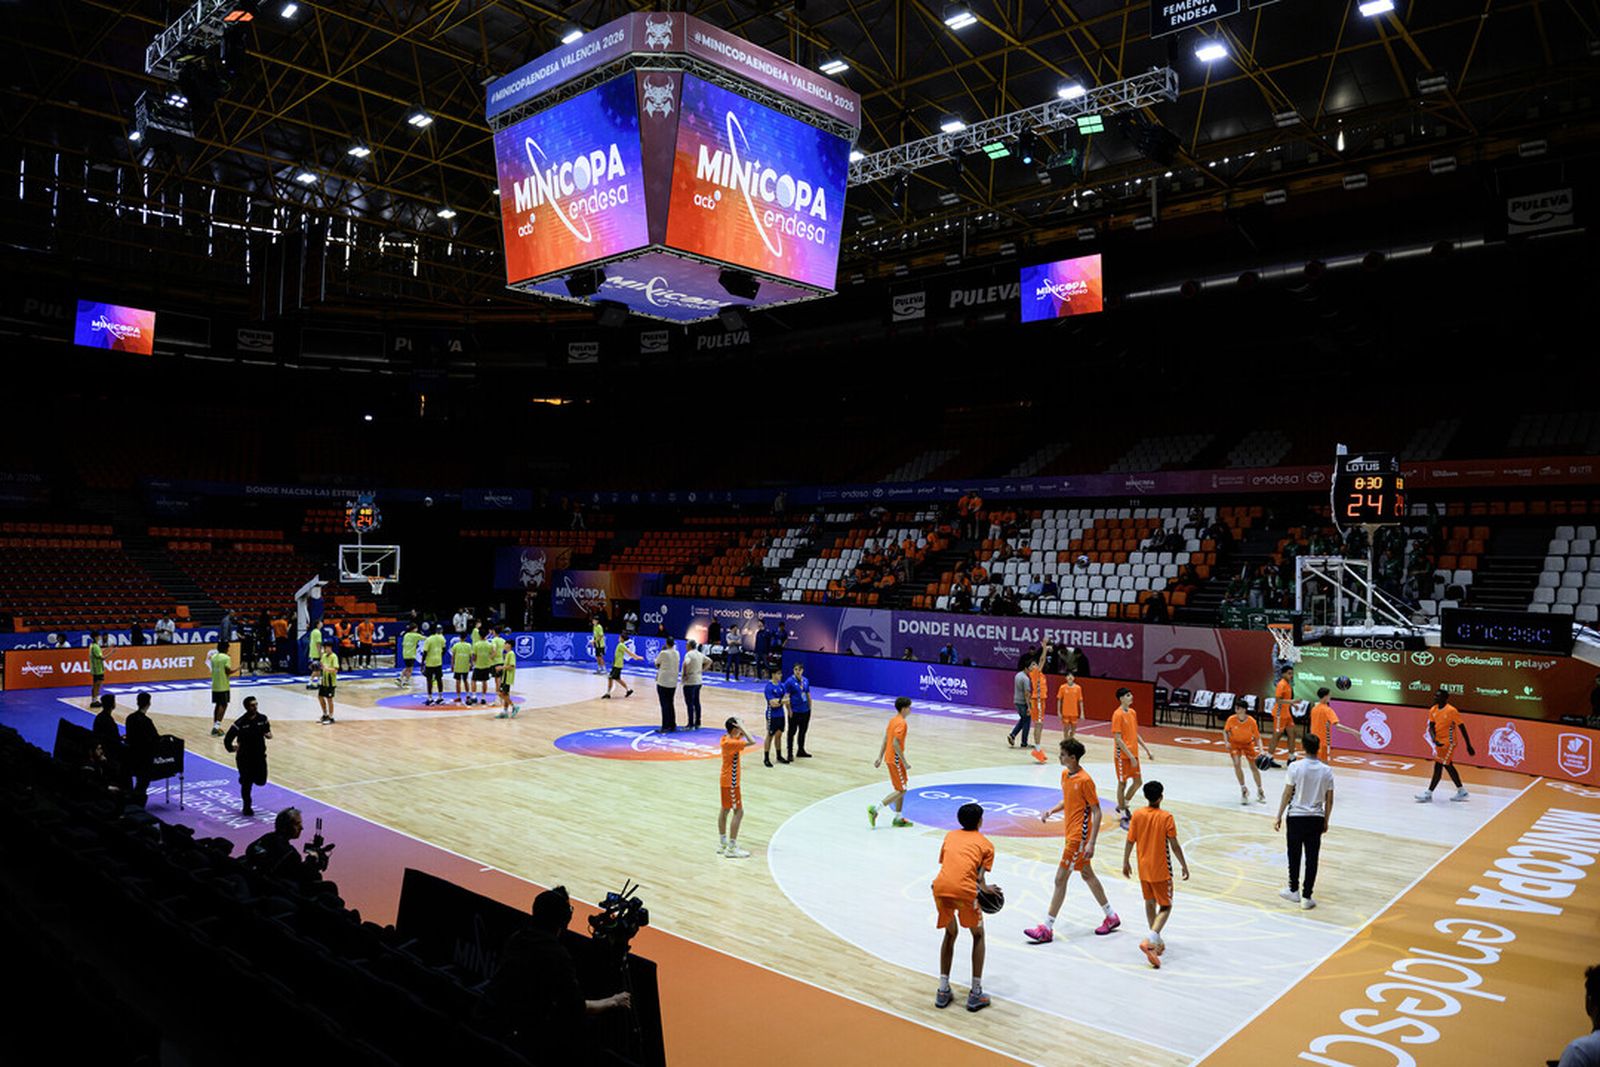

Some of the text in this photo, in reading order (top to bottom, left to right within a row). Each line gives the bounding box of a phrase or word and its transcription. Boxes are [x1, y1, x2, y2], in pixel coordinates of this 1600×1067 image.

[1171, 4, 1217, 25] ENDESA
[491, 29, 625, 104] #MINICOPAENDESA VALENCIA 2026
[694, 32, 855, 113] #MINICOPAENDESA VALENCIA 2026
[569, 184, 628, 220] endesa
[694, 193, 717, 210] acb
[1512, 194, 1569, 212] PULEVA
[518, 222, 534, 237] acb
[763, 210, 826, 245] endesa
[948, 282, 1019, 309] PULEVA
[697, 331, 752, 350] PULEVA
[1346, 463, 1380, 472] LOTUS
[1252, 475, 1300, 486] endesa
[1347, 494, 1383, 516] 24
[643, 611, 663, 624] acb
[898, 619, 1134, 650] DONDE NACEN LAS ESTRELLAS
[1343, 636, 1405, 651] endesa
[61, 656, 195, 675] VALNCIA BASKET
[1340, 650, 1401, 663] endesa
[1446, 654, 1503, 667] mediolanum
[1514, 660, 1550, 671] pelayo
[918, 790, 1066, 823] endes
